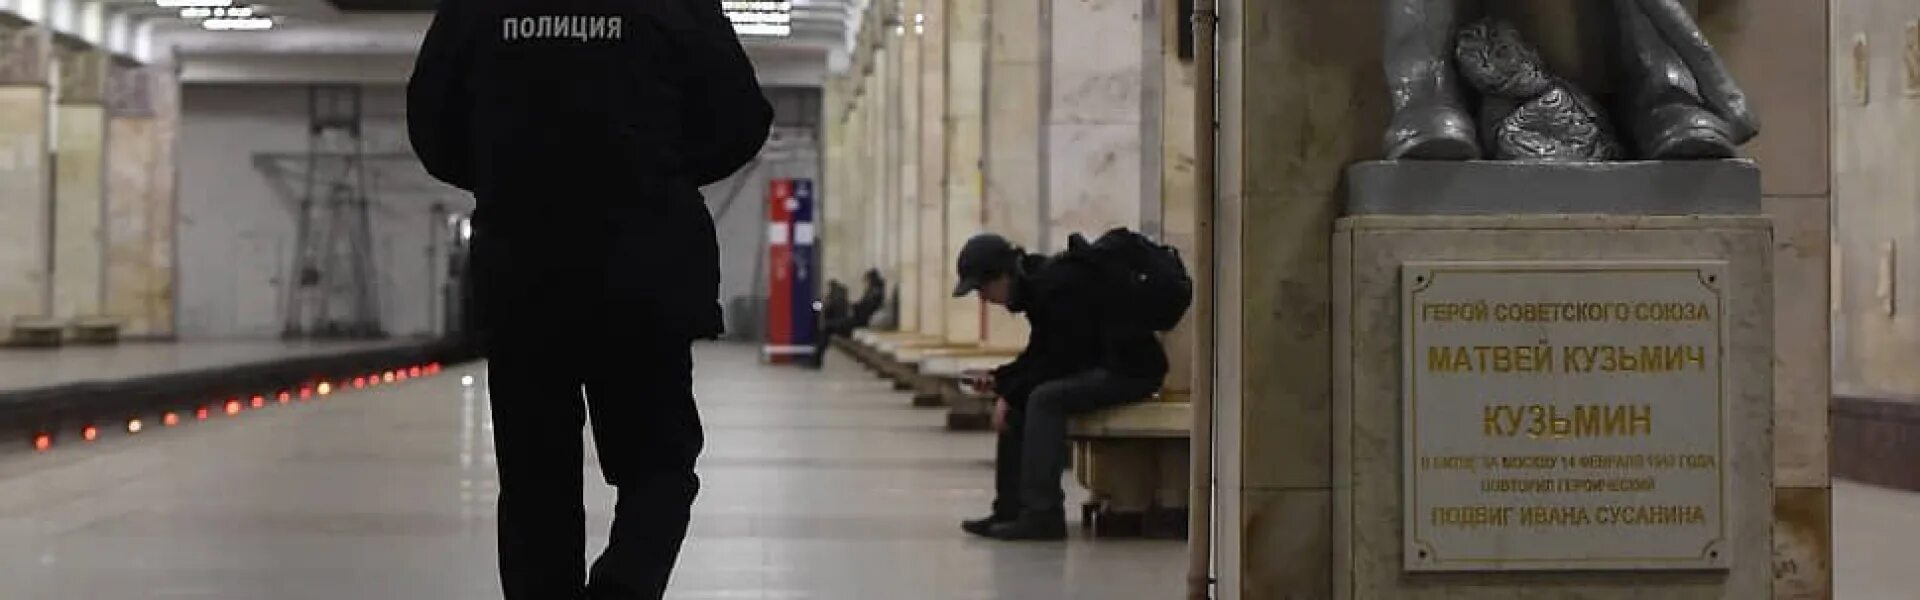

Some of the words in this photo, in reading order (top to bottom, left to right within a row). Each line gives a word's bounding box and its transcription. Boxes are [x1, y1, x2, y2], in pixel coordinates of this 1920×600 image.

[503, 15, 622, 42] ПОЛИЦИЯ
[1421, 300, 1488, 322] ГЕРОЙ
[1495, 302, 1629, 322] СОВЕТСКОГО
[1635, 302, 1710, 322] СОЮЗА
[1427, 338, 1553, 373] МАТВЕЙ
[1563, 346, 1706, 373] КУЗЬМИЧ
[1483, 404, 1652, 438] КУЗЬМИН
[1431, 505, 1514, 527] ПОДВИГ
[1520, 505, 1591, 526] ИВАНА
[1595, 504, 1705, 526] СУСАНИНА
